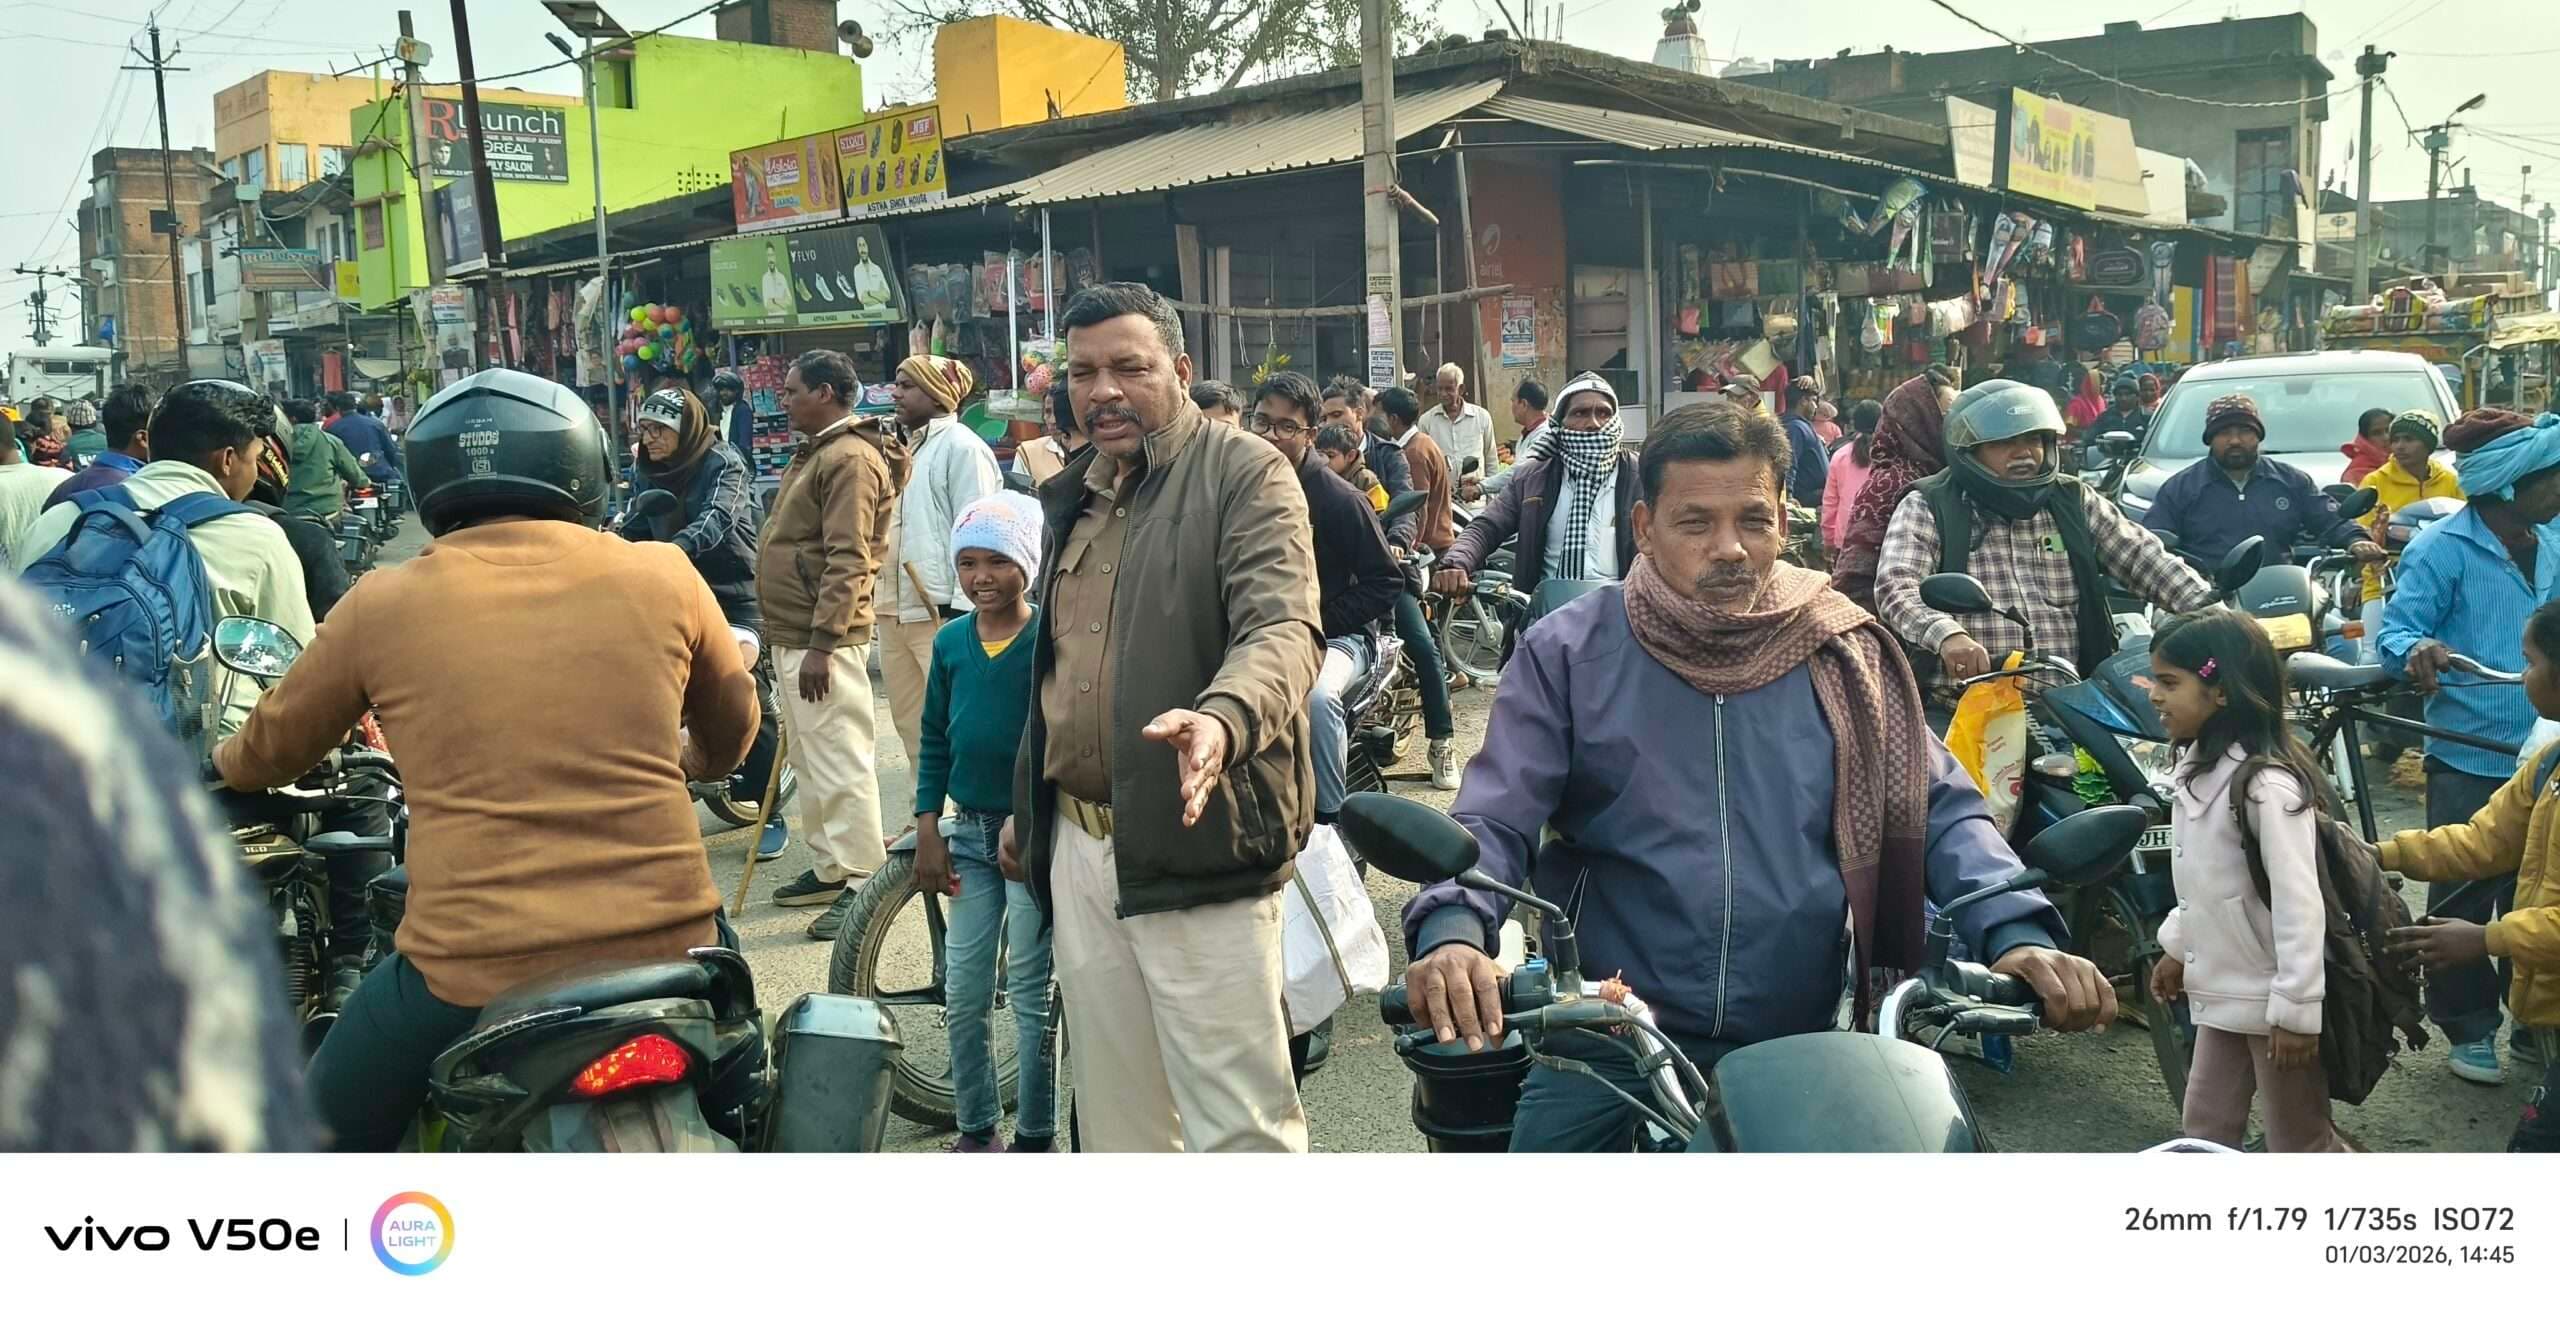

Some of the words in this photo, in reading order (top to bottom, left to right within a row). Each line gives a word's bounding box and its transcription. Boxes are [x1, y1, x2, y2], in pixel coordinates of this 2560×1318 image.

[422, 99, 559, 141] Rlunch
[504, 161, 533, 173] SALON
[459, 430, 499, 447] STUDDS
[466, 447, 488, 457] 1000
[2139, 831, 2172, 847] JH
